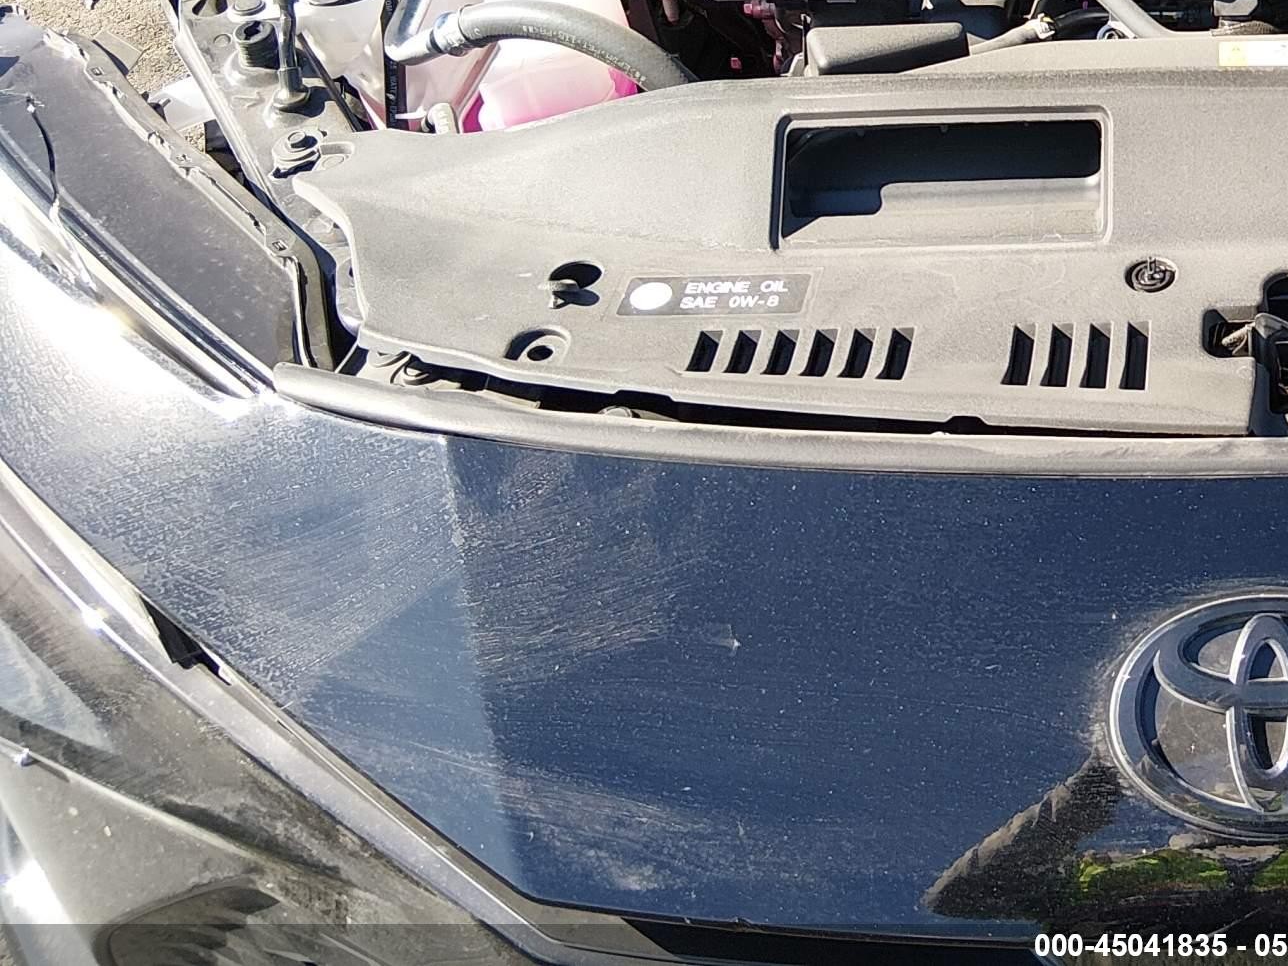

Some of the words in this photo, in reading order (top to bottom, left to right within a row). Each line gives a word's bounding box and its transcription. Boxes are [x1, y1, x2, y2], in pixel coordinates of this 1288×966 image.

[684, 281, 751, 295] ENGINE
[760, 280, 789, 293] OIL
[679, 296, 719, 309] SAE
[728, 295, 779, 308] 0W-8
